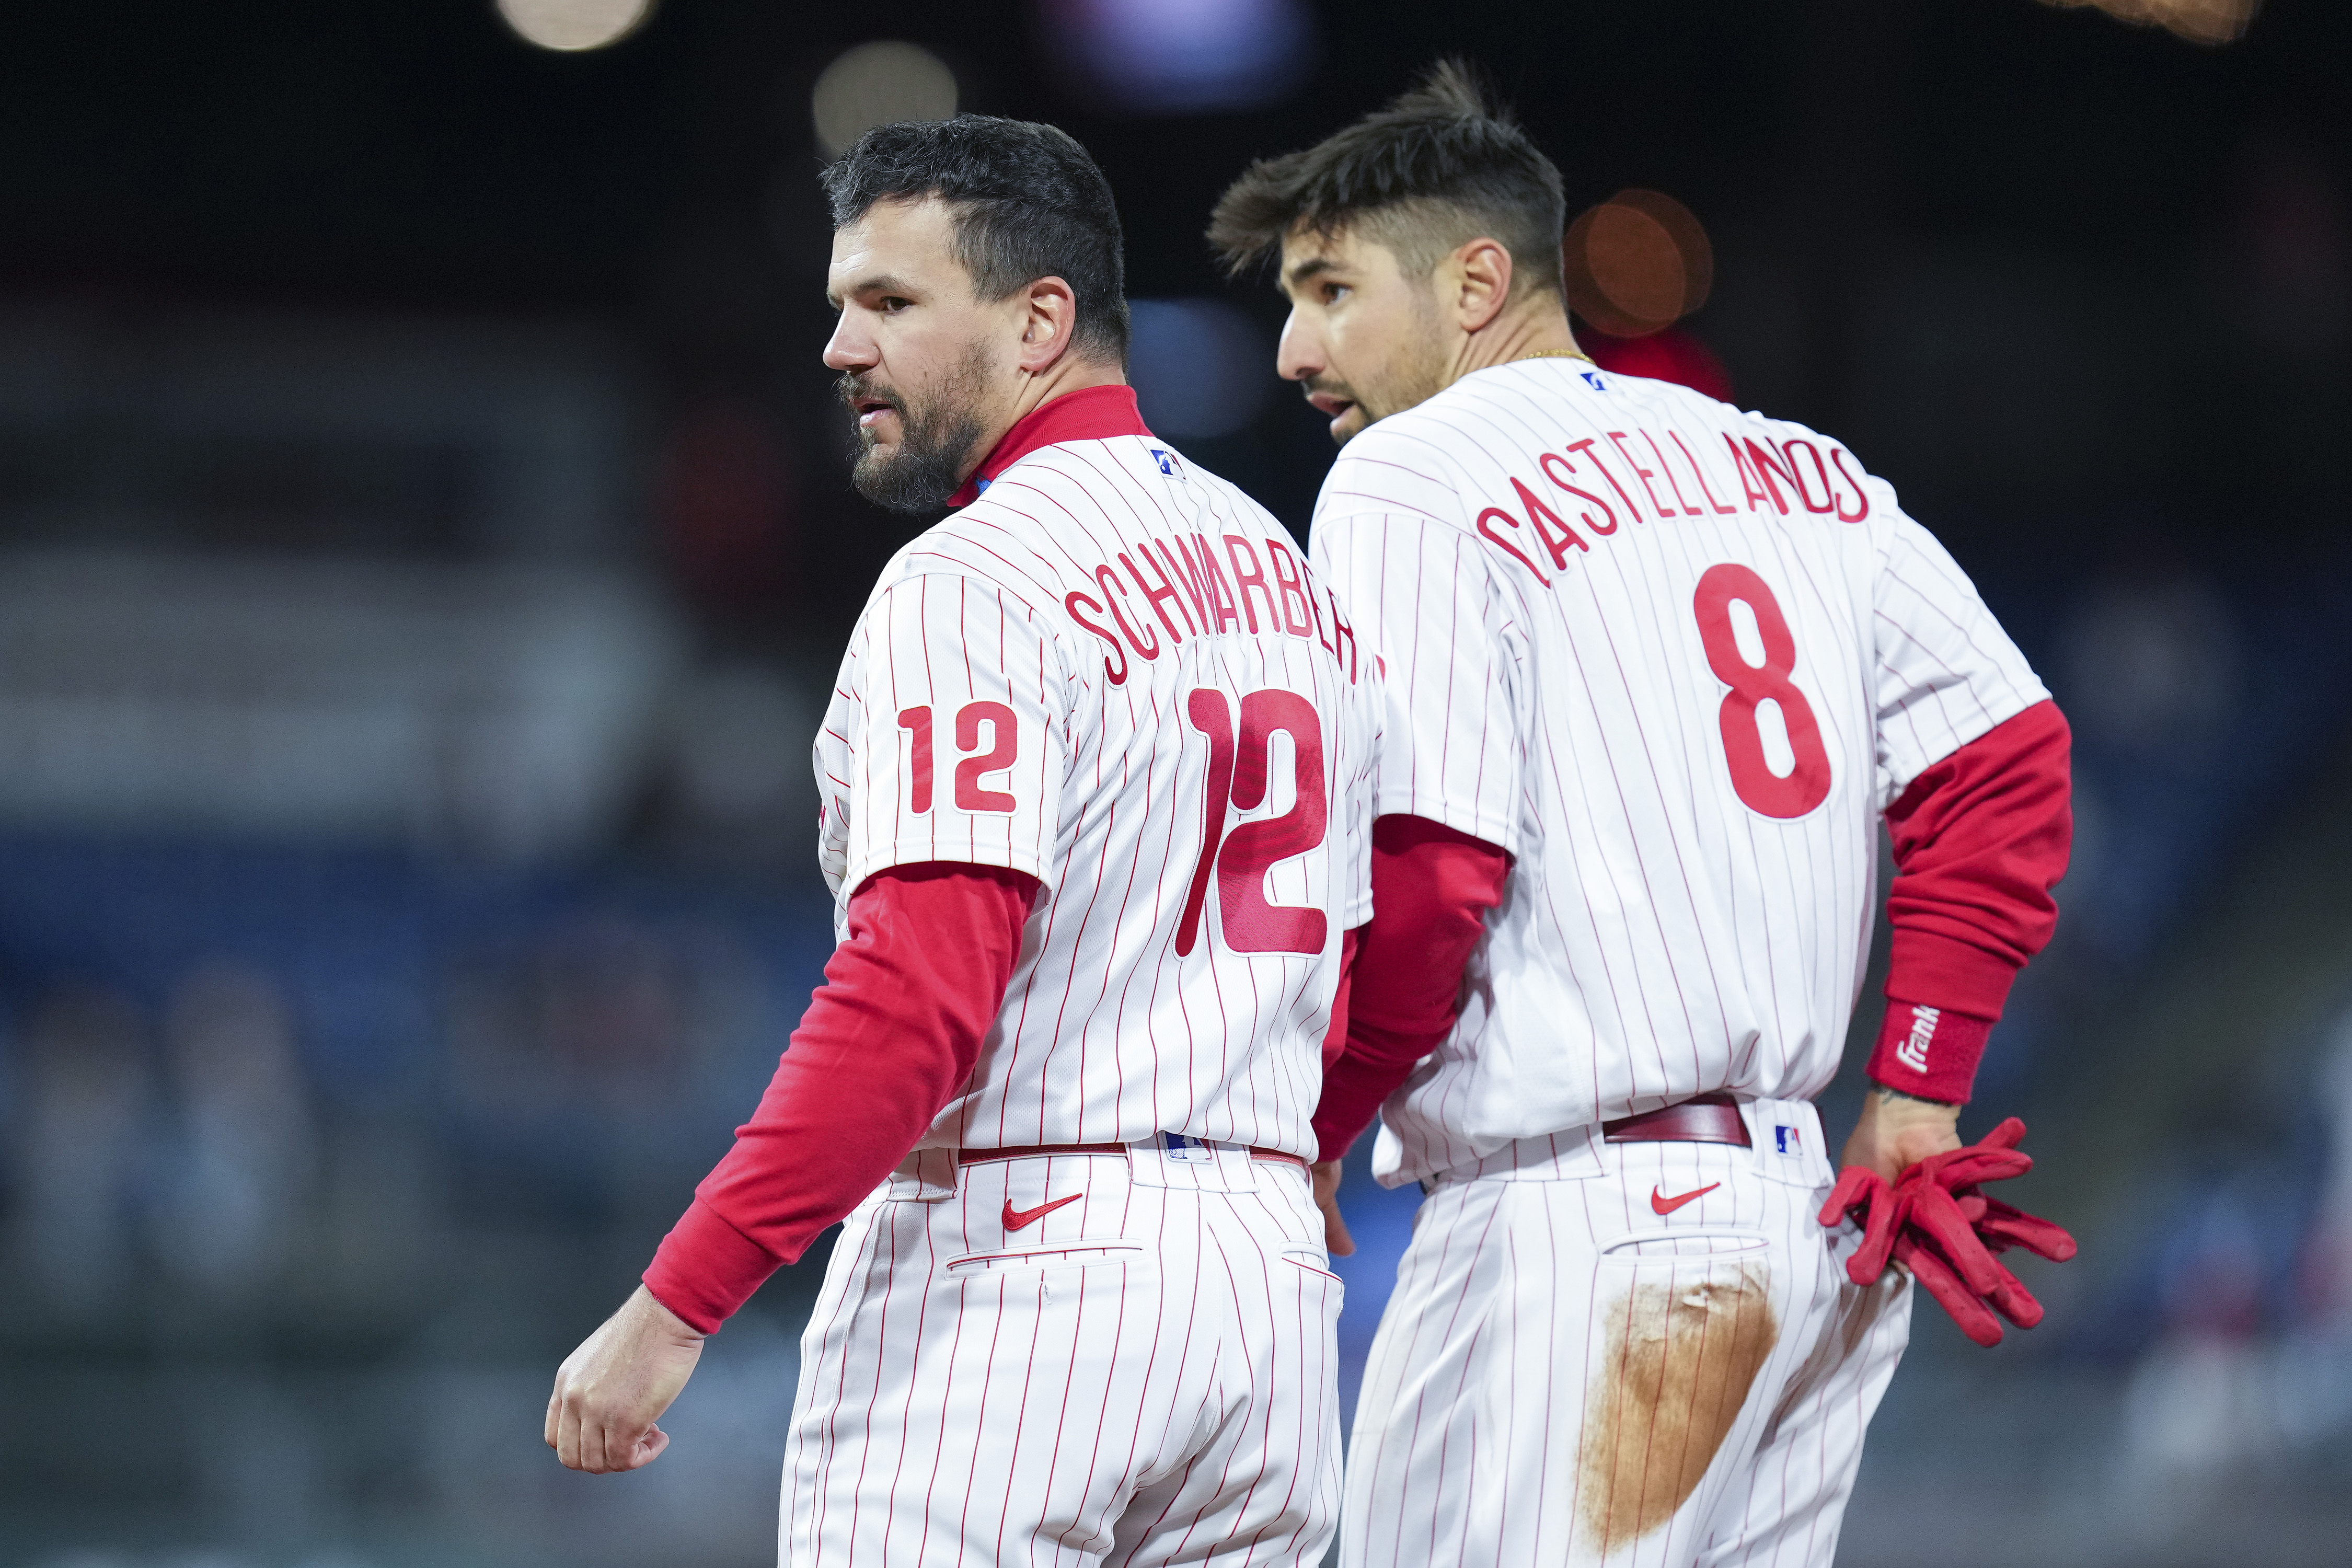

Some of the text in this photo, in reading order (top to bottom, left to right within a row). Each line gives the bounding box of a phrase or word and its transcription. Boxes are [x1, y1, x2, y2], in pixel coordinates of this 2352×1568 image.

[1477, 428, 1869, 589] CASTELLANOS
[897, 701, 1018, 813] 12
[1693, 563, 1832, 818] 8
[1174, 688, 1328, 958] 12
